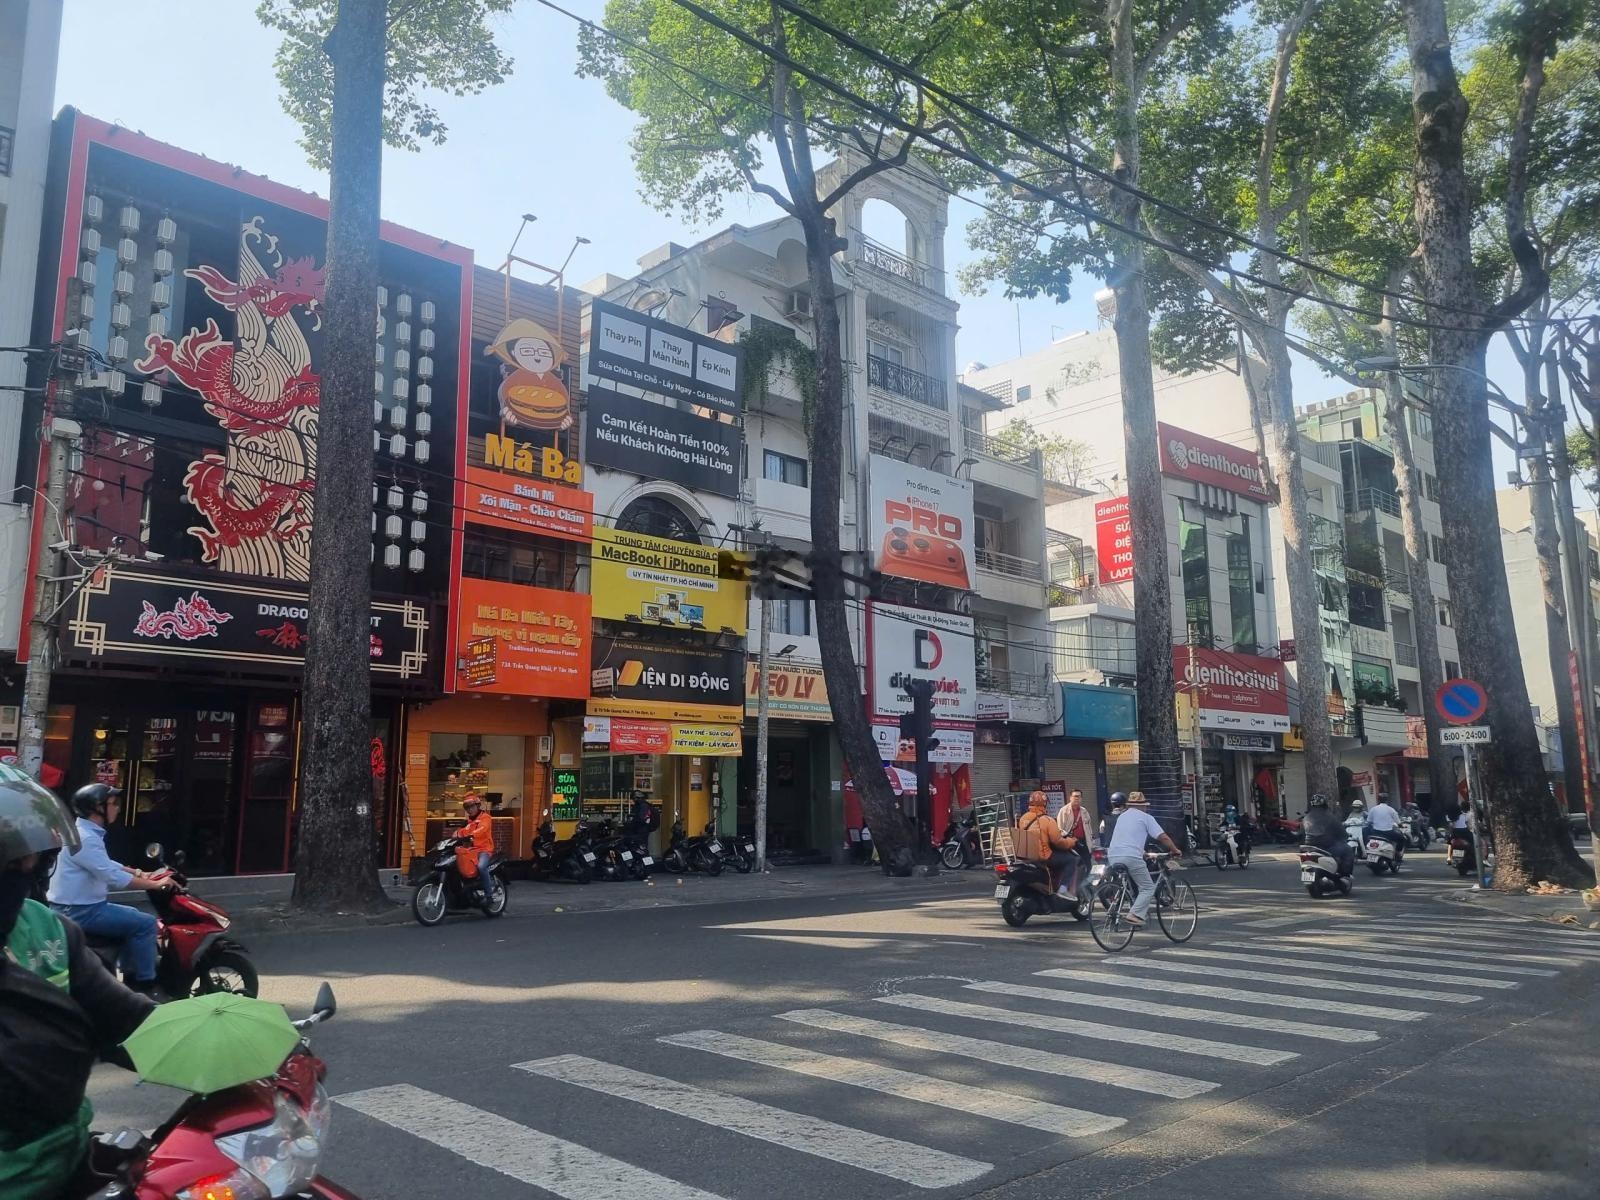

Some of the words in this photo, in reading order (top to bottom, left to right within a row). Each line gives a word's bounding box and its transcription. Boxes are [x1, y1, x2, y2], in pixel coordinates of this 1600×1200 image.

[605, 328, 625, 344] Thay
[628, 336, 642, 347] Pin
[662, 340, 681, 354] Thay
[702, 358, 712, 371] Ép
[676, 384, 692, 395] Ngay
[602, 414, 627, 428] Cam
[630, 420, 648, 434] Kết
[650, 426, 677, 443] Hoàn
[678, 432, 700, 448] Tiền
[702, 440, 729, 456] 100%
[596, 427, 618, 443] Nếu
[621, 434, 655, 452] Khách
[657, 443, 690, 462] Không
[691, 453, 708, 466] Hài
[710, 458, 733, 473] Lòng
[485, 432, 533, 473] Má
[542, 446, 581, 484] Ba
[1187, 446, 1259, 482] dienthoaiv
[514, 484, 539, 498] Bánh
[906, 480, 916, 489] Pro
[885, 499, 962, 540] PRO
[614, 535, 642, 548] TRUNG
[644, 539, 660, 551] TÂM
[662, 544, 694, 556] CHUYÊN
[696, 548, 712, 559] SỬA
[1115, 536, 1131, 549] ĐIỆ
[601, 545, 662, 567] MacBook
[669, 556, 710, 574] iPhone
[1113, 552, 1132, 564] THO
[1110, 566, 1134, 580] LAPT
[258, 604, 309, 619] DRAGO
[501, 608, 519, 621] Ba
[670, 673, 684, 687] DI
[689, 672, 729, 692] ĐỘNG
[1443, 732, 1459, 741] 6:00
[1466, 730, 1487, 739] 24:00
[558, 773, 575, 783] SỬA
[555, 785, 578, 794] CHỮA
[356, 806, 367, 815] 33
